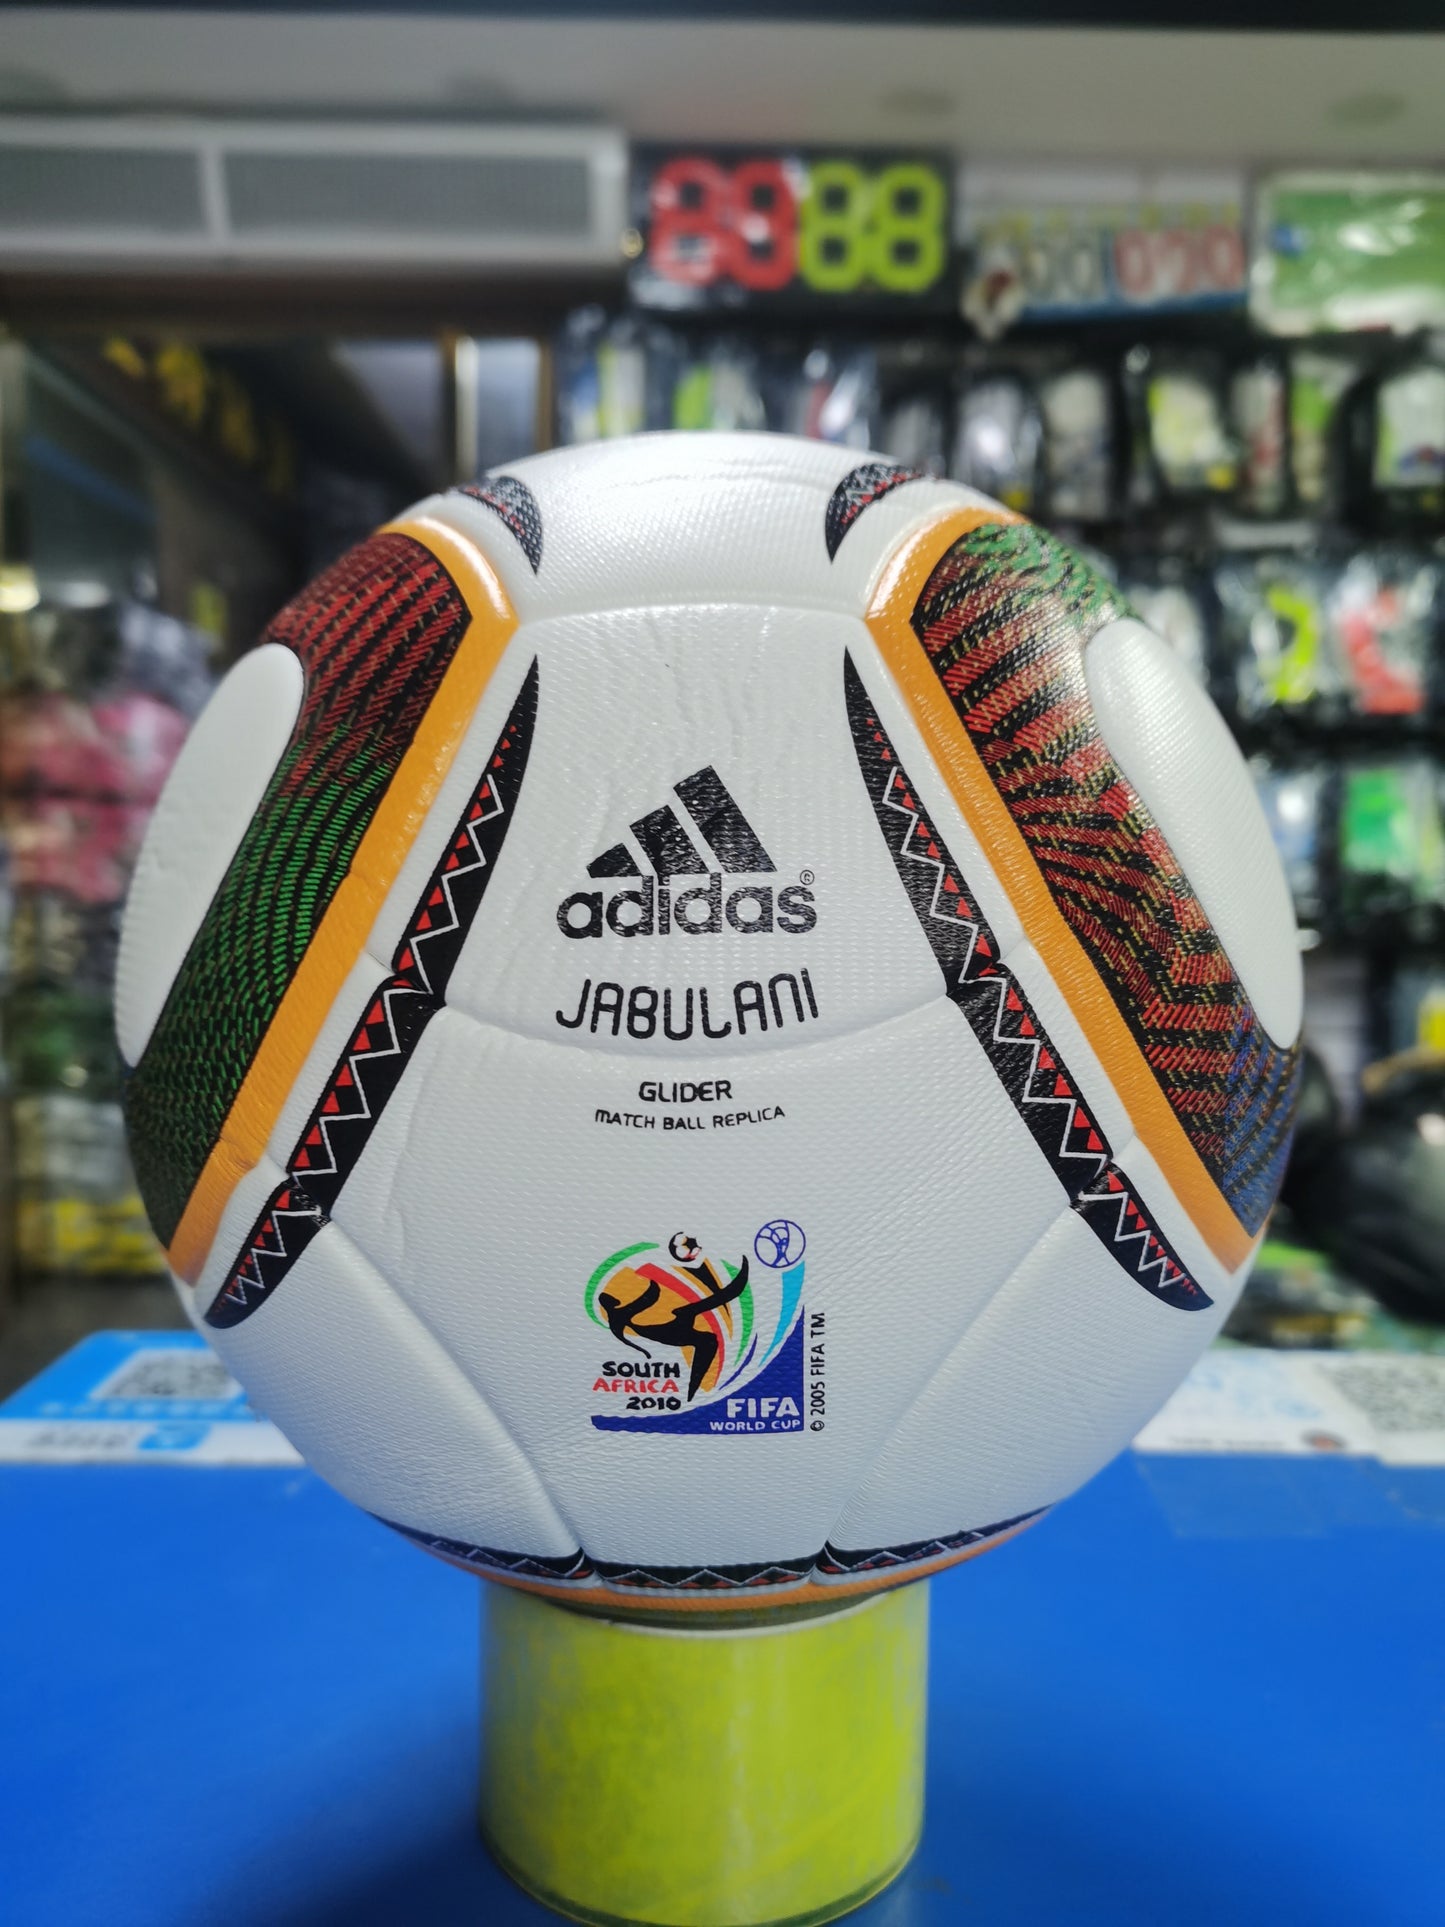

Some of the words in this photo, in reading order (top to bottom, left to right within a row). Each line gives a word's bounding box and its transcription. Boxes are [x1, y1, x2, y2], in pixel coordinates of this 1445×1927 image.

[556, 872, 817, 939] adidas
[556, 967, 818, 1040] JABULANI
[638, 1080, 733, 1102] GLIDER
[595, 1109, 655, 1129] MATCH
[663, 1116, 706, 1130] BALL
[712, 1105, 786, 1128] REPLICA
[810, 1312, 825, 1338] TM
[602, 1361, 681, 1378] SOUTH
[810, 1343, 825, 1376] FIFA
[592, 1378, 679, 1393] AFRICA
[626, 1396, 682, 1411] 2010
[727, 1397, 800, 1419] FIFA
[810, 1381, 825, 1416] 2005
[709, 1421, 766, 1432] WORLD
[771, 1419, 801, 1430] CUP
